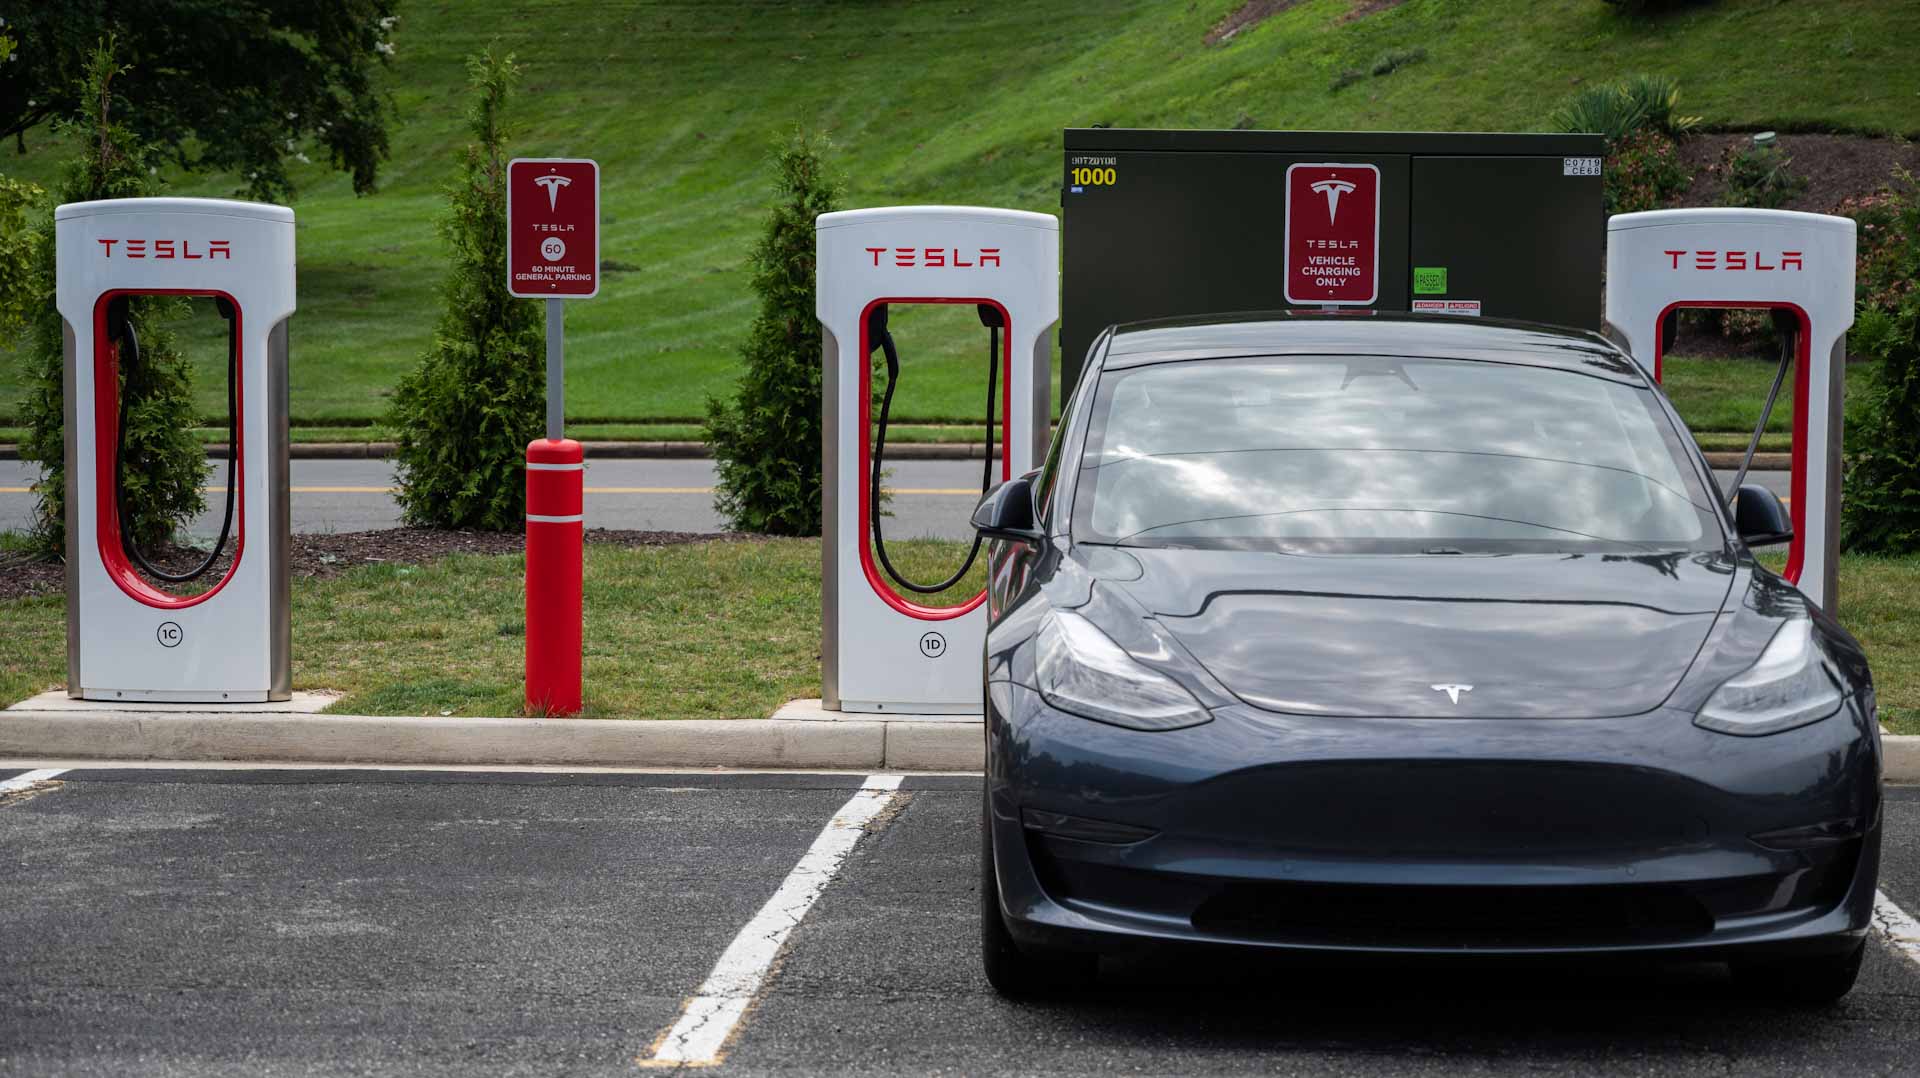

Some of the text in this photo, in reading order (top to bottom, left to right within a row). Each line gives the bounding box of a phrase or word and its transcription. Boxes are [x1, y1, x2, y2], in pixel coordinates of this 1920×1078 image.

[1565, 158, 1600, 166] C0719
[1071, 167, 1117, 185] 1000
[532, 223, 575, 232] TESLA
[97, 239, 231, 259] TESLA
[545, 244, 562, 254] 60
[1306, 239, 1359, 249] TESLA
[865, 247, 1000, 267] TESLA
[1308, 255, 1356, 266] VEHICLE
[1664, 250, 1802, 271] TESLA
[531, 265, 576, 273] 60 MINUTE
[1302, 266, 1361, 276] CHARGING
[515, 273, 592, 281] GENERAL PARKING
[1315, 277, 1347, 287] ONLY
[162, 629, 177, 640] 1C
[925, 639, 941, 650] 1D
